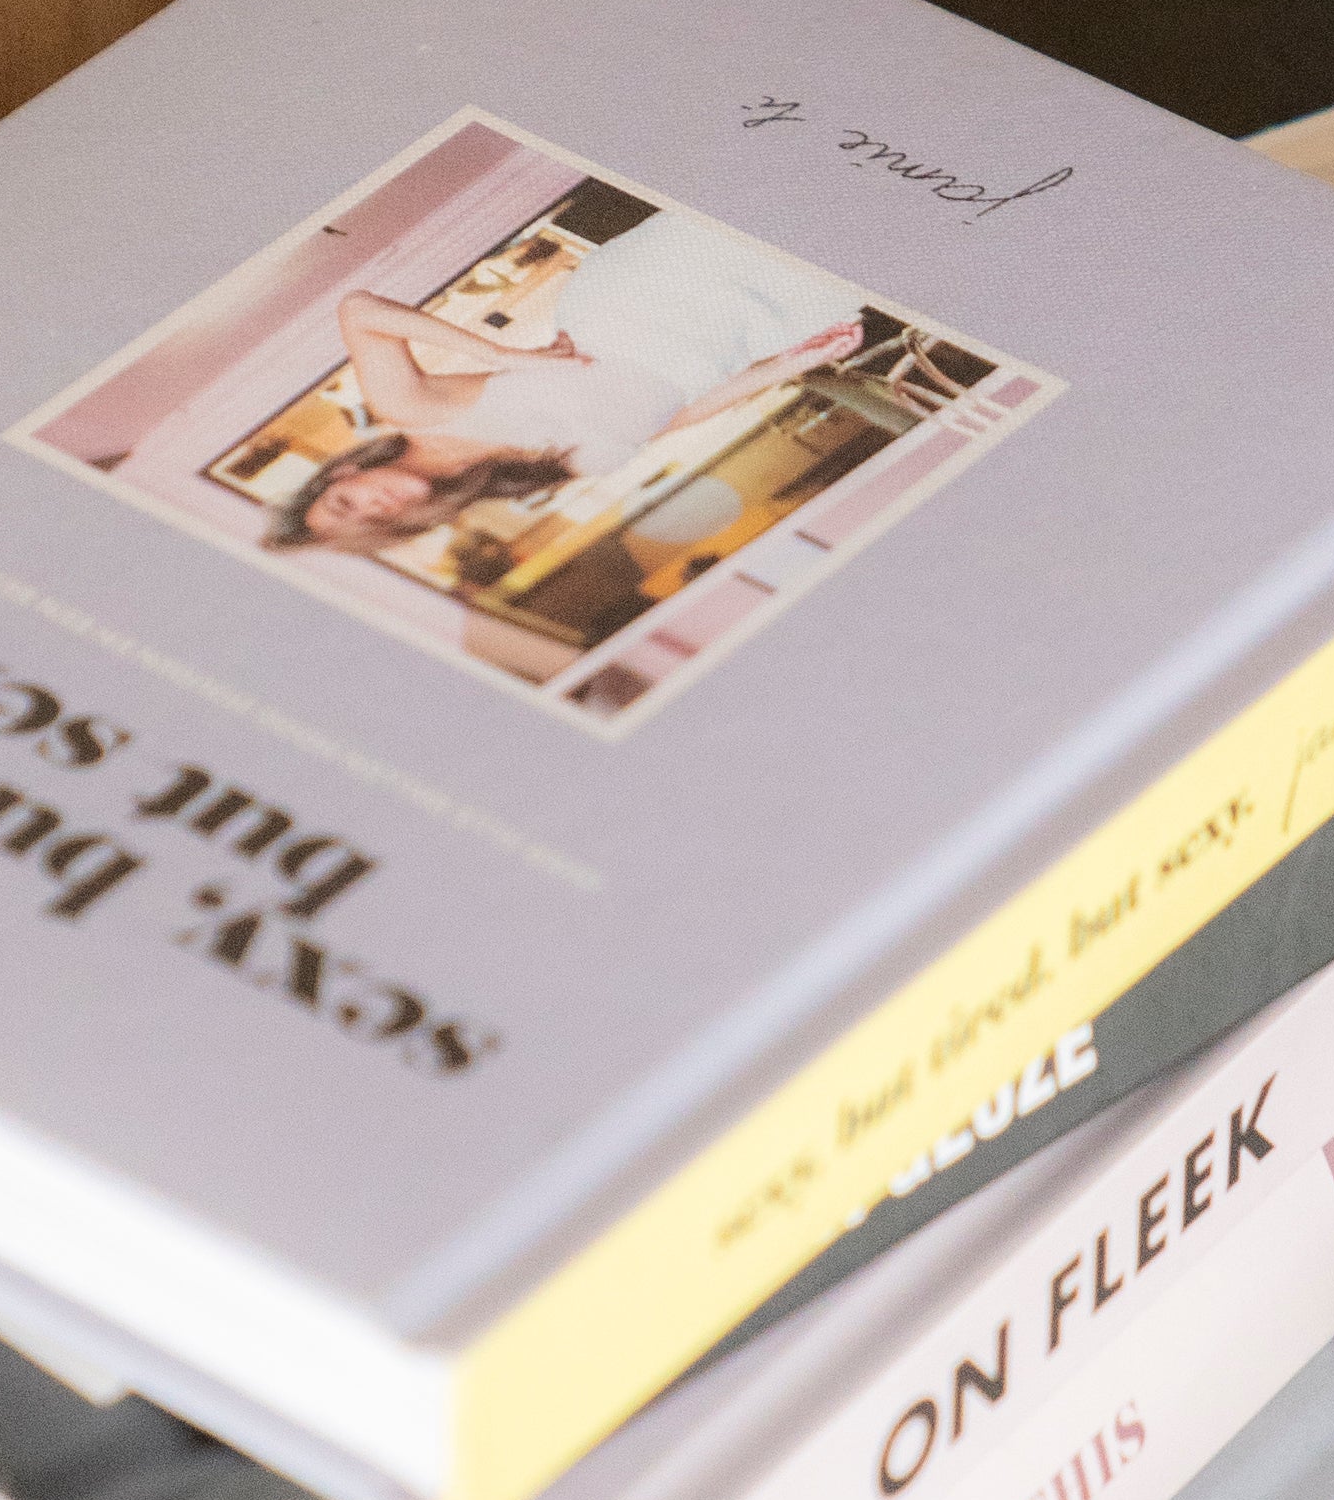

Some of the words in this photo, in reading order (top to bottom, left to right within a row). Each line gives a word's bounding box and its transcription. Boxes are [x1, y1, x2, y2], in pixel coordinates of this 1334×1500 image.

[837, 129, 1074, 226] jamie
[132, 761, 381, 924] but
[1067, 870, 1142, 958] but
[878, 1318, 1011, 1498] ON
[1046, 1070, 1278, 1356] FLEEK
